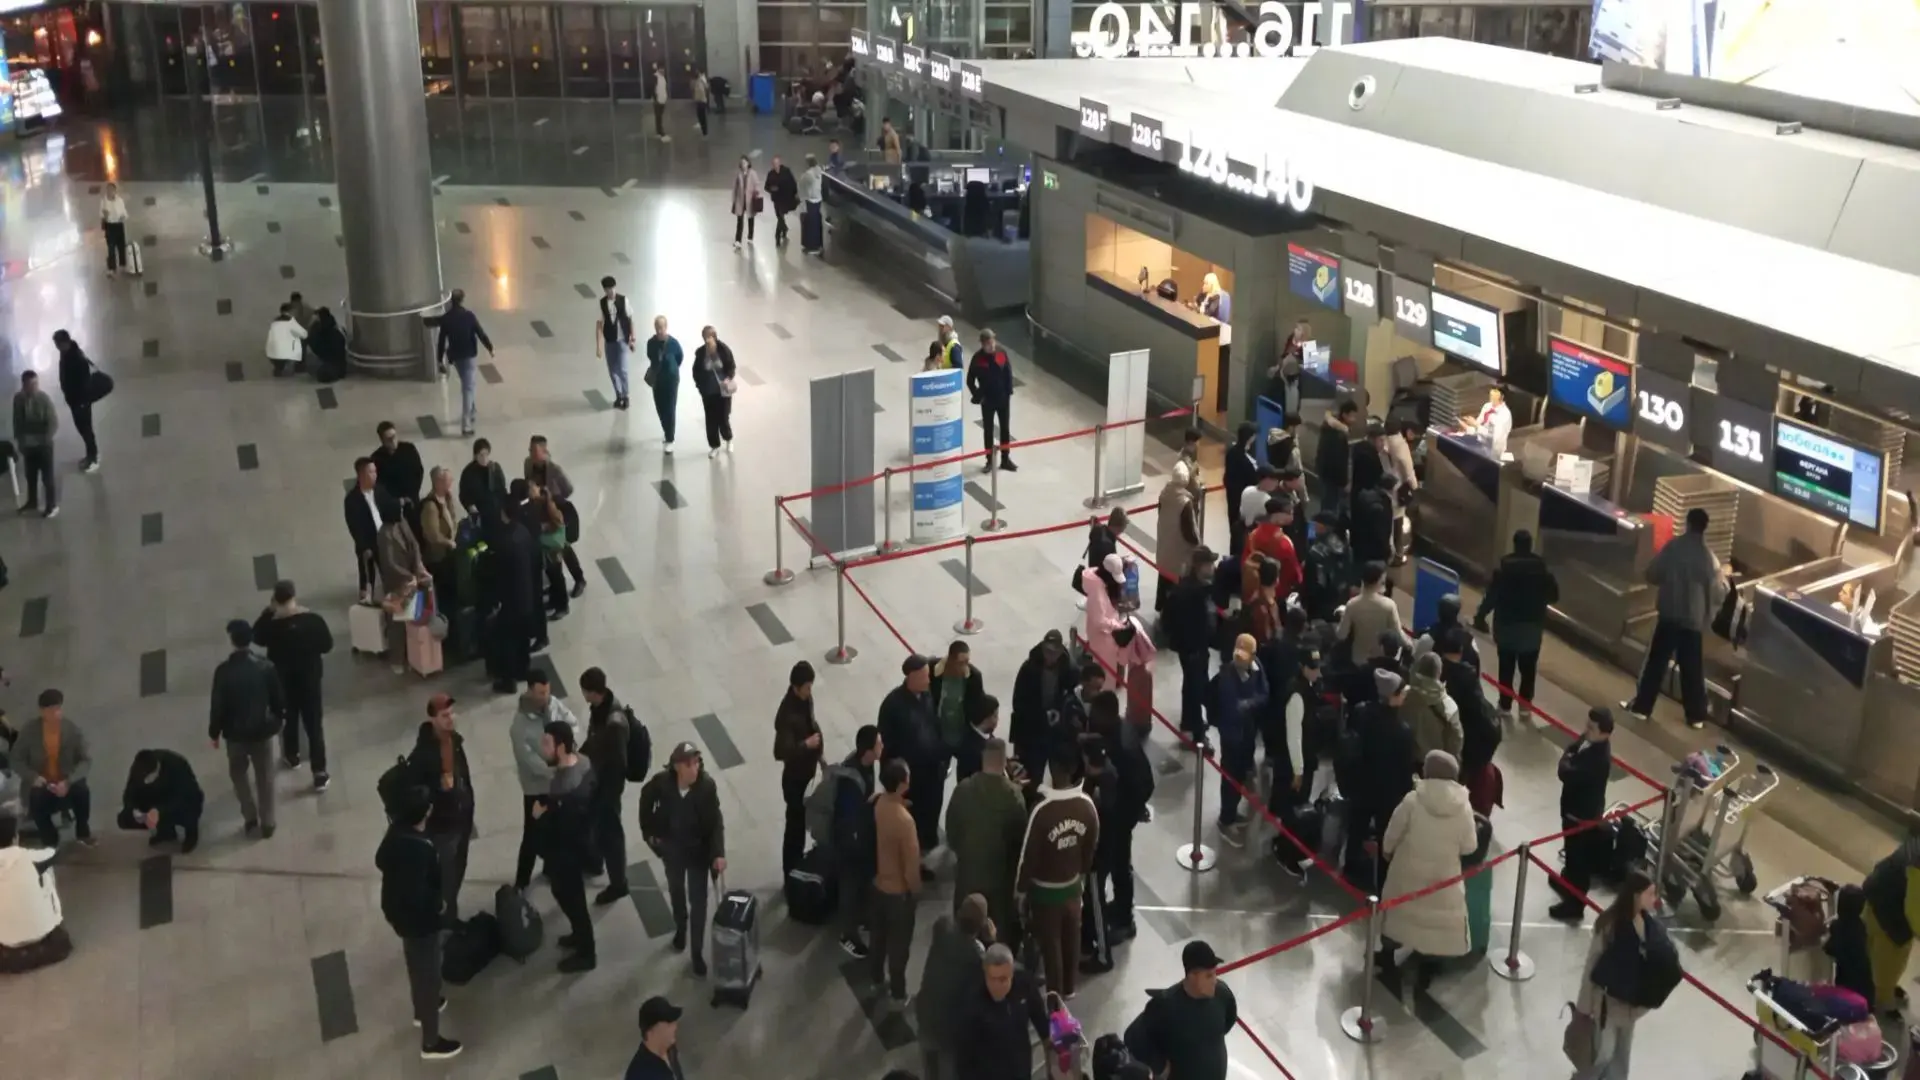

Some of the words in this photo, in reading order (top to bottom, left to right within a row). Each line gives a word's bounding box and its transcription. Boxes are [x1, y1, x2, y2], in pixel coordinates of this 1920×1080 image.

[944, 64, 950, 82] D
[976, 74, 981, 93] E
[1081, 107, 1099, 131] 128
[1099, 114, 1107, 132] F
[1131, 122, 1151, 148] 128
[1151, 130, 1161, 151] G
[1345, 276, 1374, 307] 128
[1396, 295, 1427, 327] 129
[1639, 390, 1683, 431] 130
[1719, 419, 1763, 463] 131
